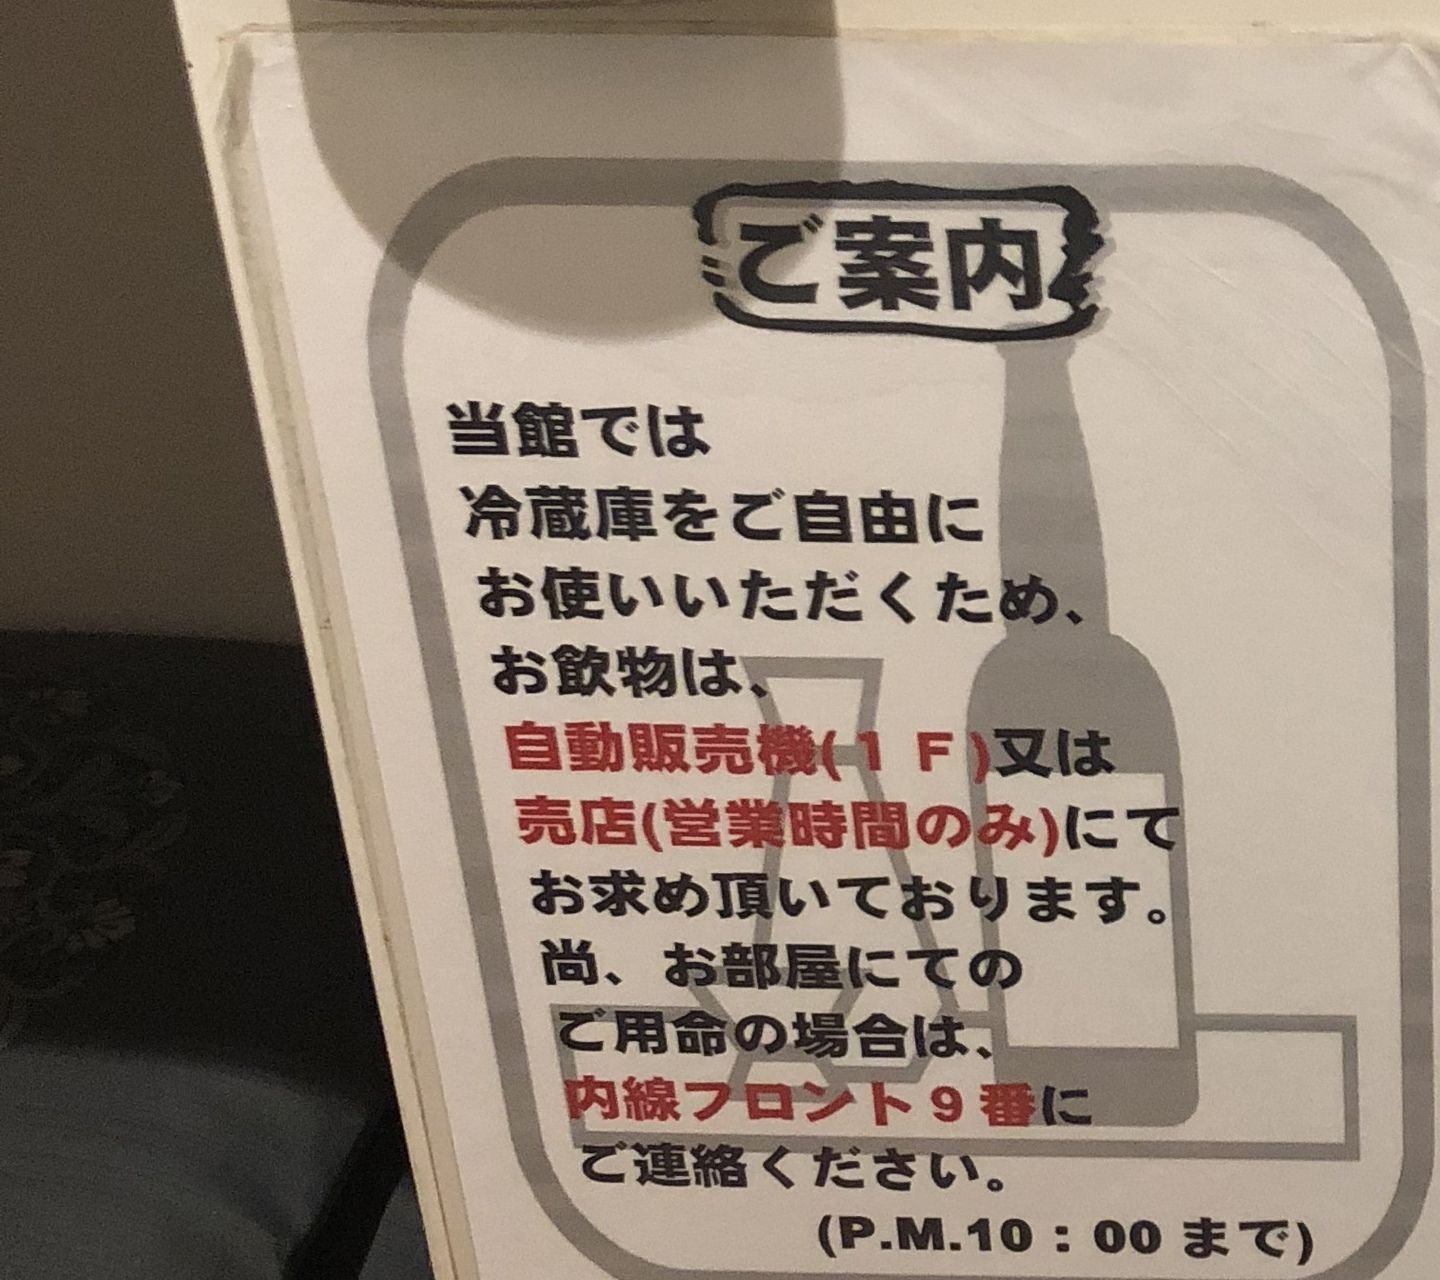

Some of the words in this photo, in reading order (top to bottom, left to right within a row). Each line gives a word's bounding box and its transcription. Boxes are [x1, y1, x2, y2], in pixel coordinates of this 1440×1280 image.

[736, 214, 1045, 313] ご案内
[446, 400, 712, 459] 当館では
[460, 485, 985, 545] 冷蔵庫をご自由に
[477, 566, 1085, 626] お使いいただくため、
[491, 645, 771, 699] お飲物は、
[516, 797, 1181, 858] 売店(営業時間のみ)にて
[530, 871, 1172, 927] お求め頂いております。
[542, 940, 1025, 992] 尚、お部屋にての
[557, 1009, 997, 1060] ご用命の場合は、
[580, 1144, 1010, 1194] ご連絡ください。
